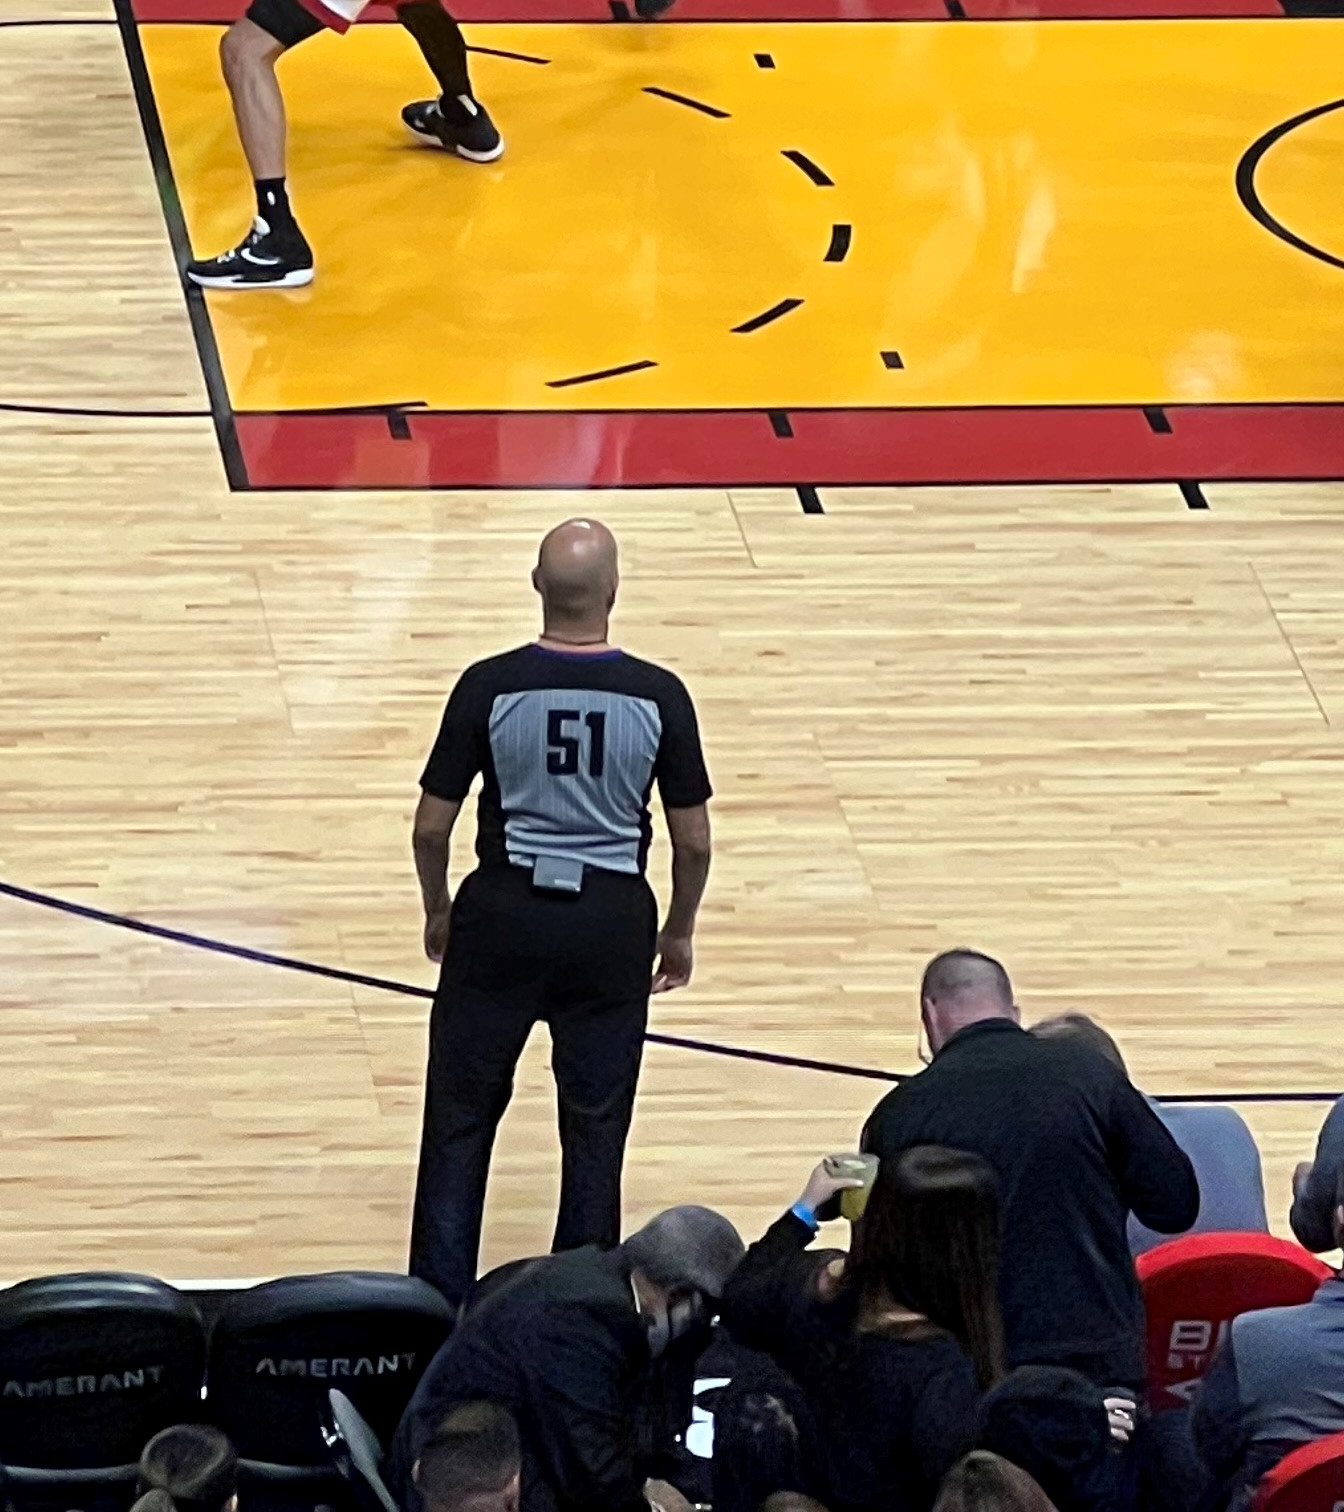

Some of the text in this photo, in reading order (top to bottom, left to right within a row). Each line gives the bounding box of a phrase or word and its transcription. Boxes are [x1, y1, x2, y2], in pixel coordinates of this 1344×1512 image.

[546, 709, 606, 778] 51
[3, 1364, 166, 1398] AMERANT
[255, 1352, 417, 1378] AMERANT
